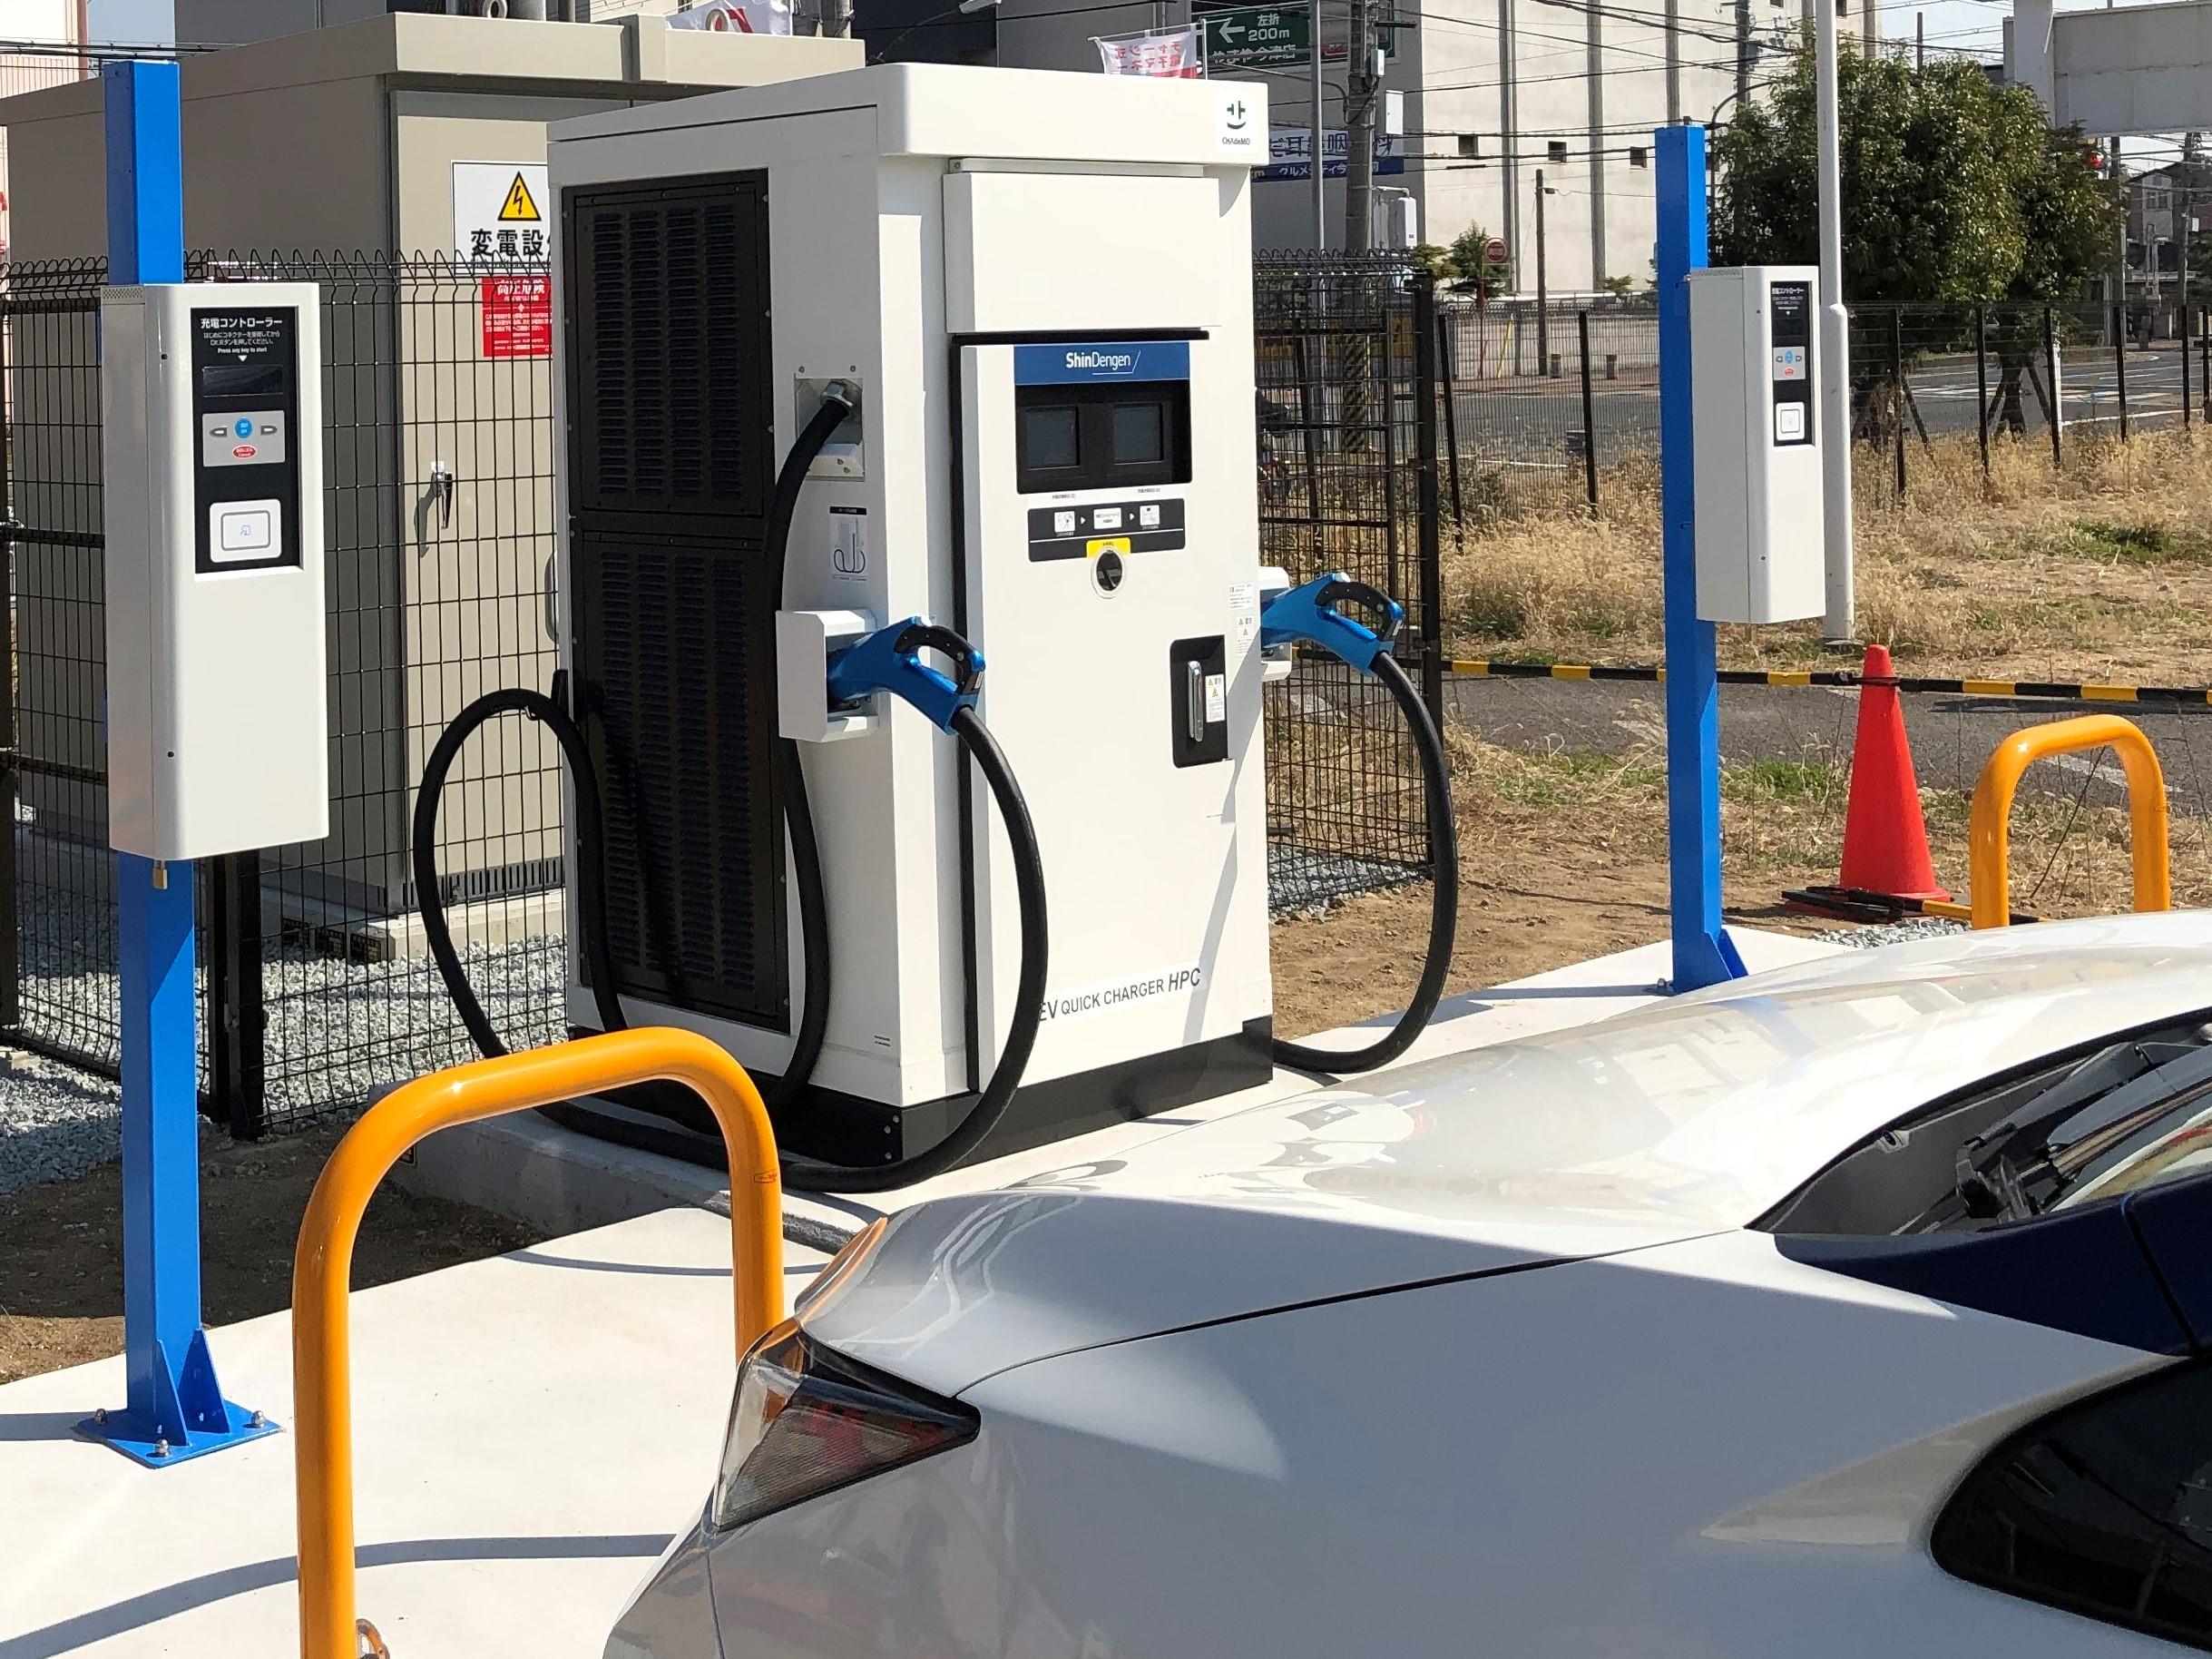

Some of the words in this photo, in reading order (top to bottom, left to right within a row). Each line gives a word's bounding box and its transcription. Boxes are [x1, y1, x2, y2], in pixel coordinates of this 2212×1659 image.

[1258, 13, 1280, 27] 左折
[1248, 28, 1290, 42] 200m
[470, 228, 551, 256] 変電設
[201, 318, 283, 329] 充電コントローラー
[1065, 351, 1131, 370] ShinDengen
[1040, 999, 1059, 1022] EV
[1061, 993, 1101, 1015] QUICK
[1103, 978, 1165, 1005] CHARGER
[1168, 967, 1202, 992] HPC
